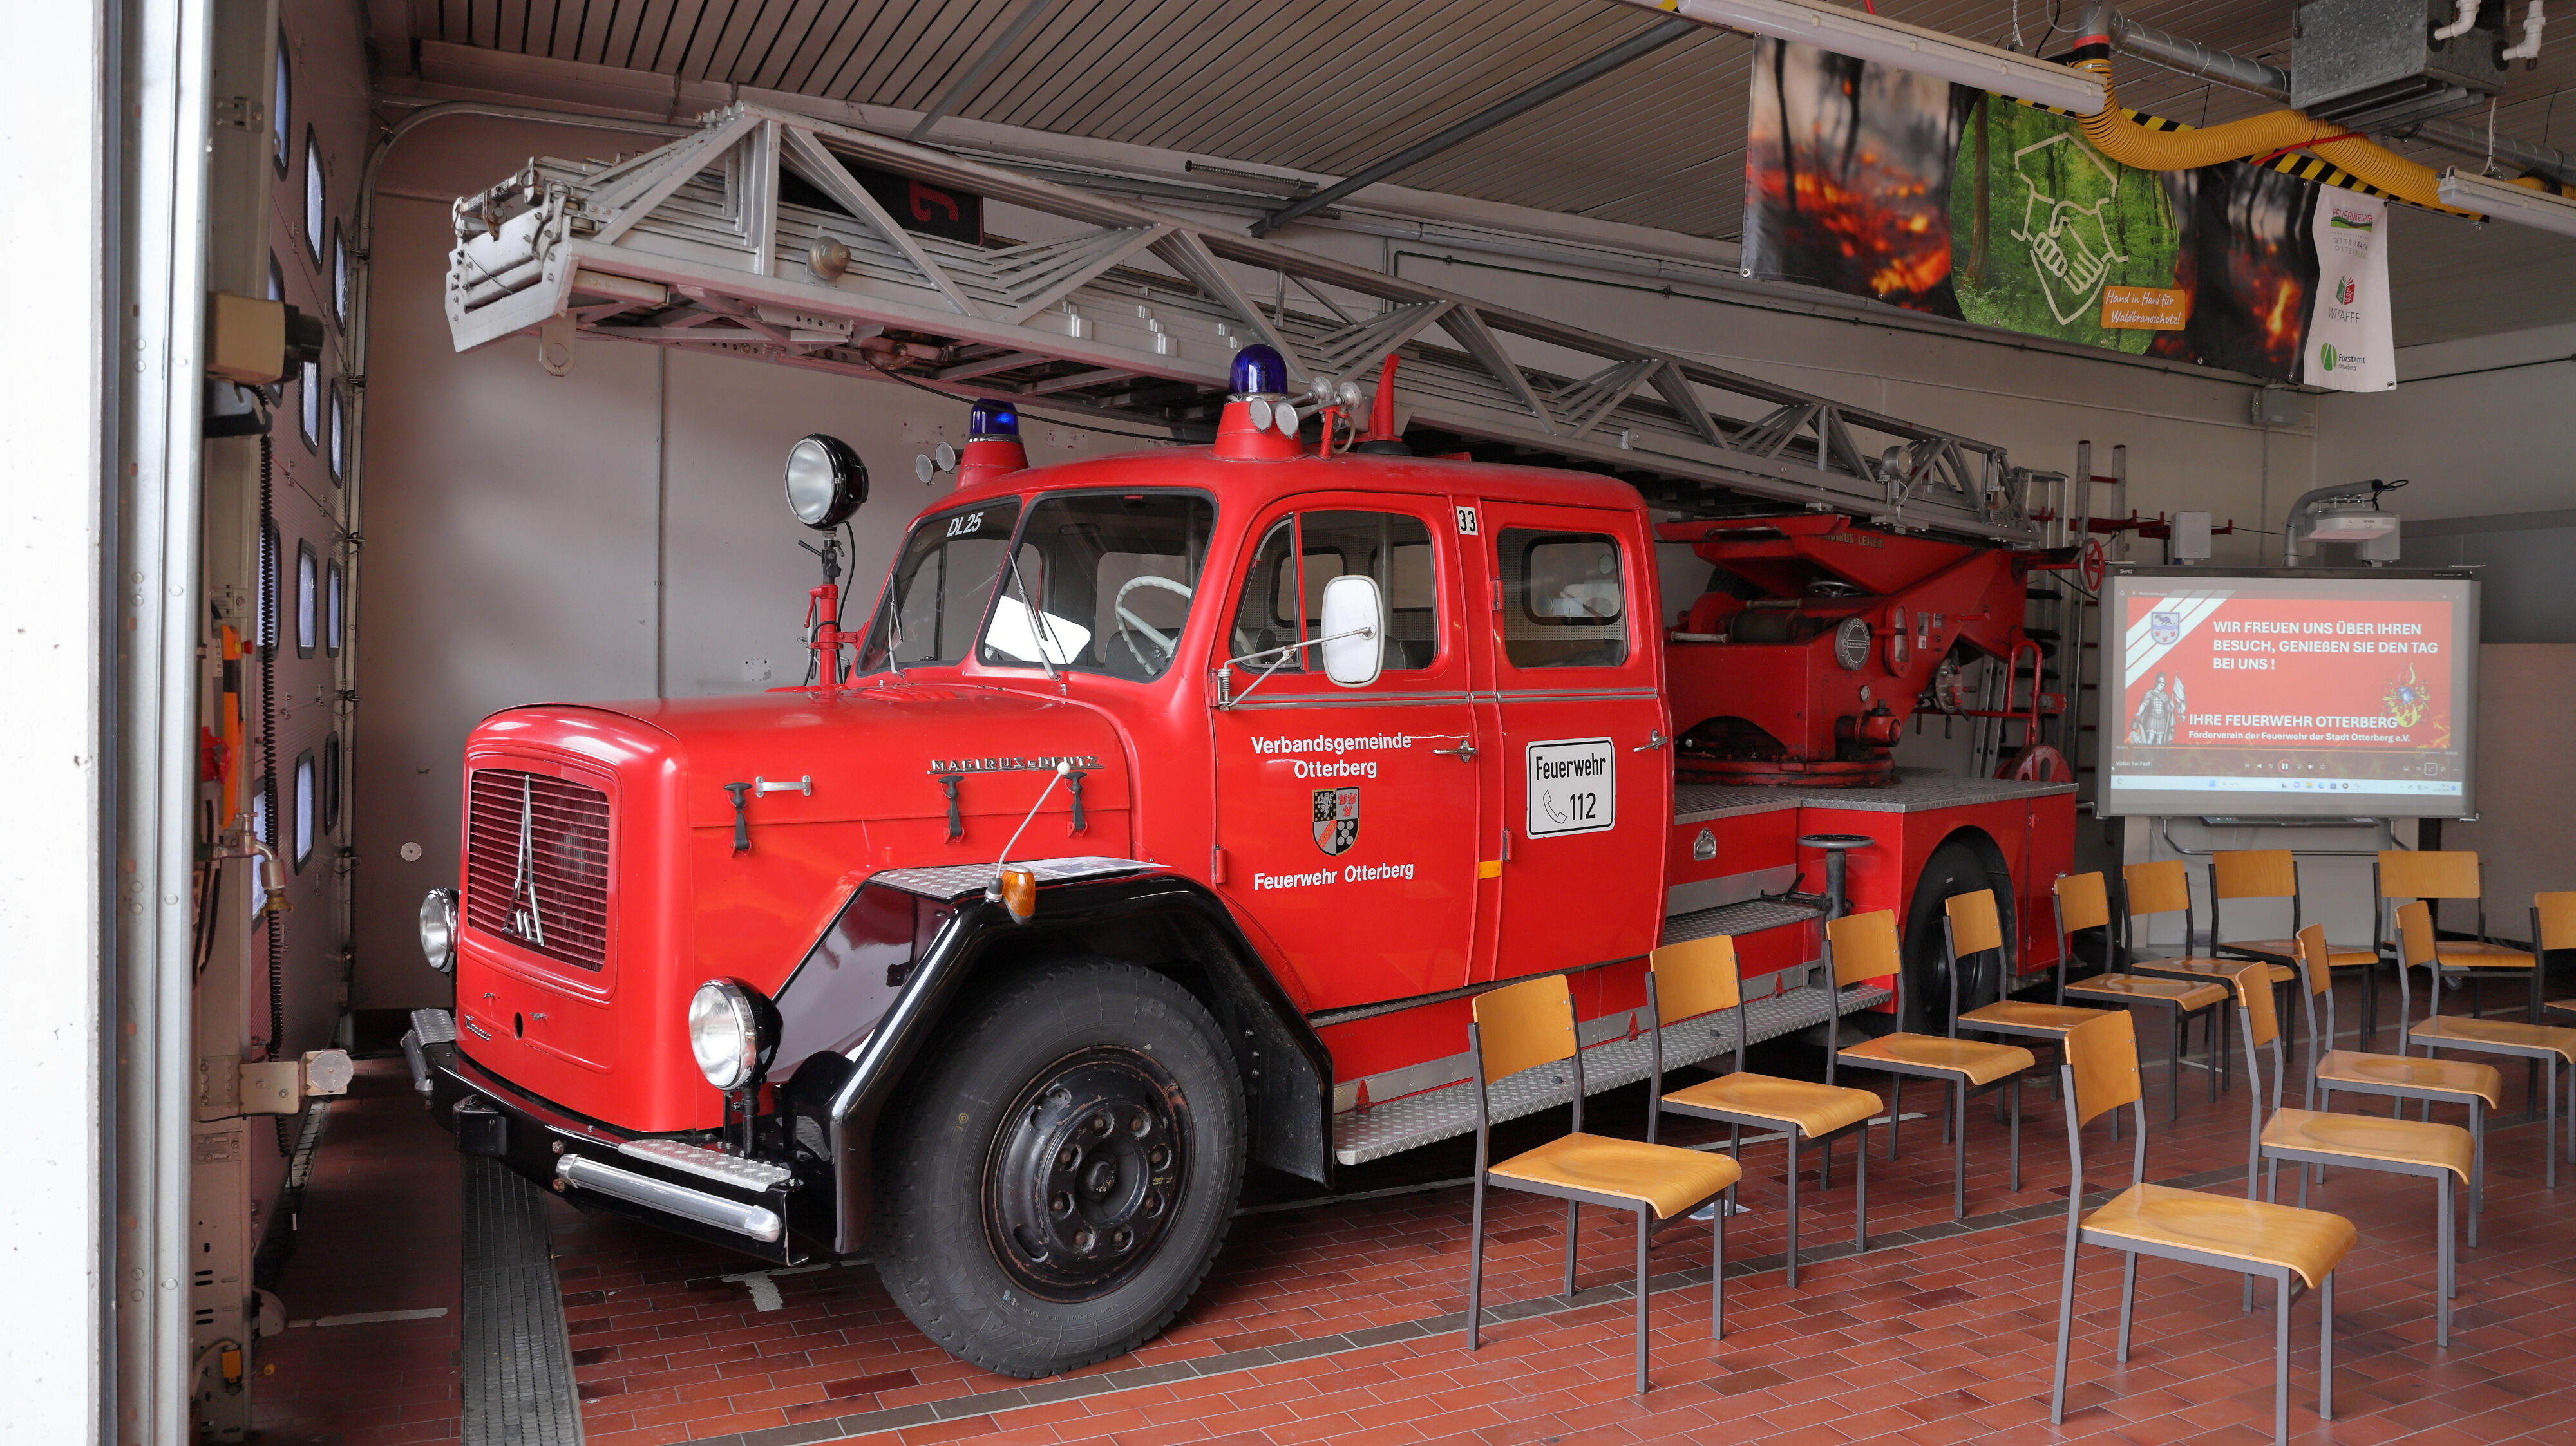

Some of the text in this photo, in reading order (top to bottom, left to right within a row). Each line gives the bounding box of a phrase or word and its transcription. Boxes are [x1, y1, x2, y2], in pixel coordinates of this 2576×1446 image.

[2332, 208, 2373, 222] FEUERWEHR
[2333, 238, 2369, 251] OTTERBACH
[2105, 290, 2174, 307] Hand in Hand für
[2111, 310, 2182, 324] Waldbrandschutz!
[2338, 353, 2365, 364] Forstamt
[2338, 363, 2356, 372] Otterberg
[946, 512, 985, 537] DL 25
[1458, 509, 1476, 532] 33
[2213, 620, 2421, 635] WIR FREUEN UNS ÜBER IHREN
[2213, 639, 2438, 653] BESUCH, GENIEßEN SIE DEN TAG
[2213, 657, 2275, 670] BEI UNS !
[2190, 714, 2398, 728] IHRE FEUERWEHR OTTERBERG
[1251, 732, 1412, 755] Verbandsgemeinde
[2189, 730, 2243, 739] Förderverein
[2325, 733, 2349, 741] Stadt
[2351, 733, 2394, 743] Otterberg
[1294, 759, 1378, 779] Otterberg
[1536, 752, 1606, 780] Feuerwehr
[1569, 792, 1596, 821] 112
[1254, 863, 1414, 890] Feuerwehr Otterberg
